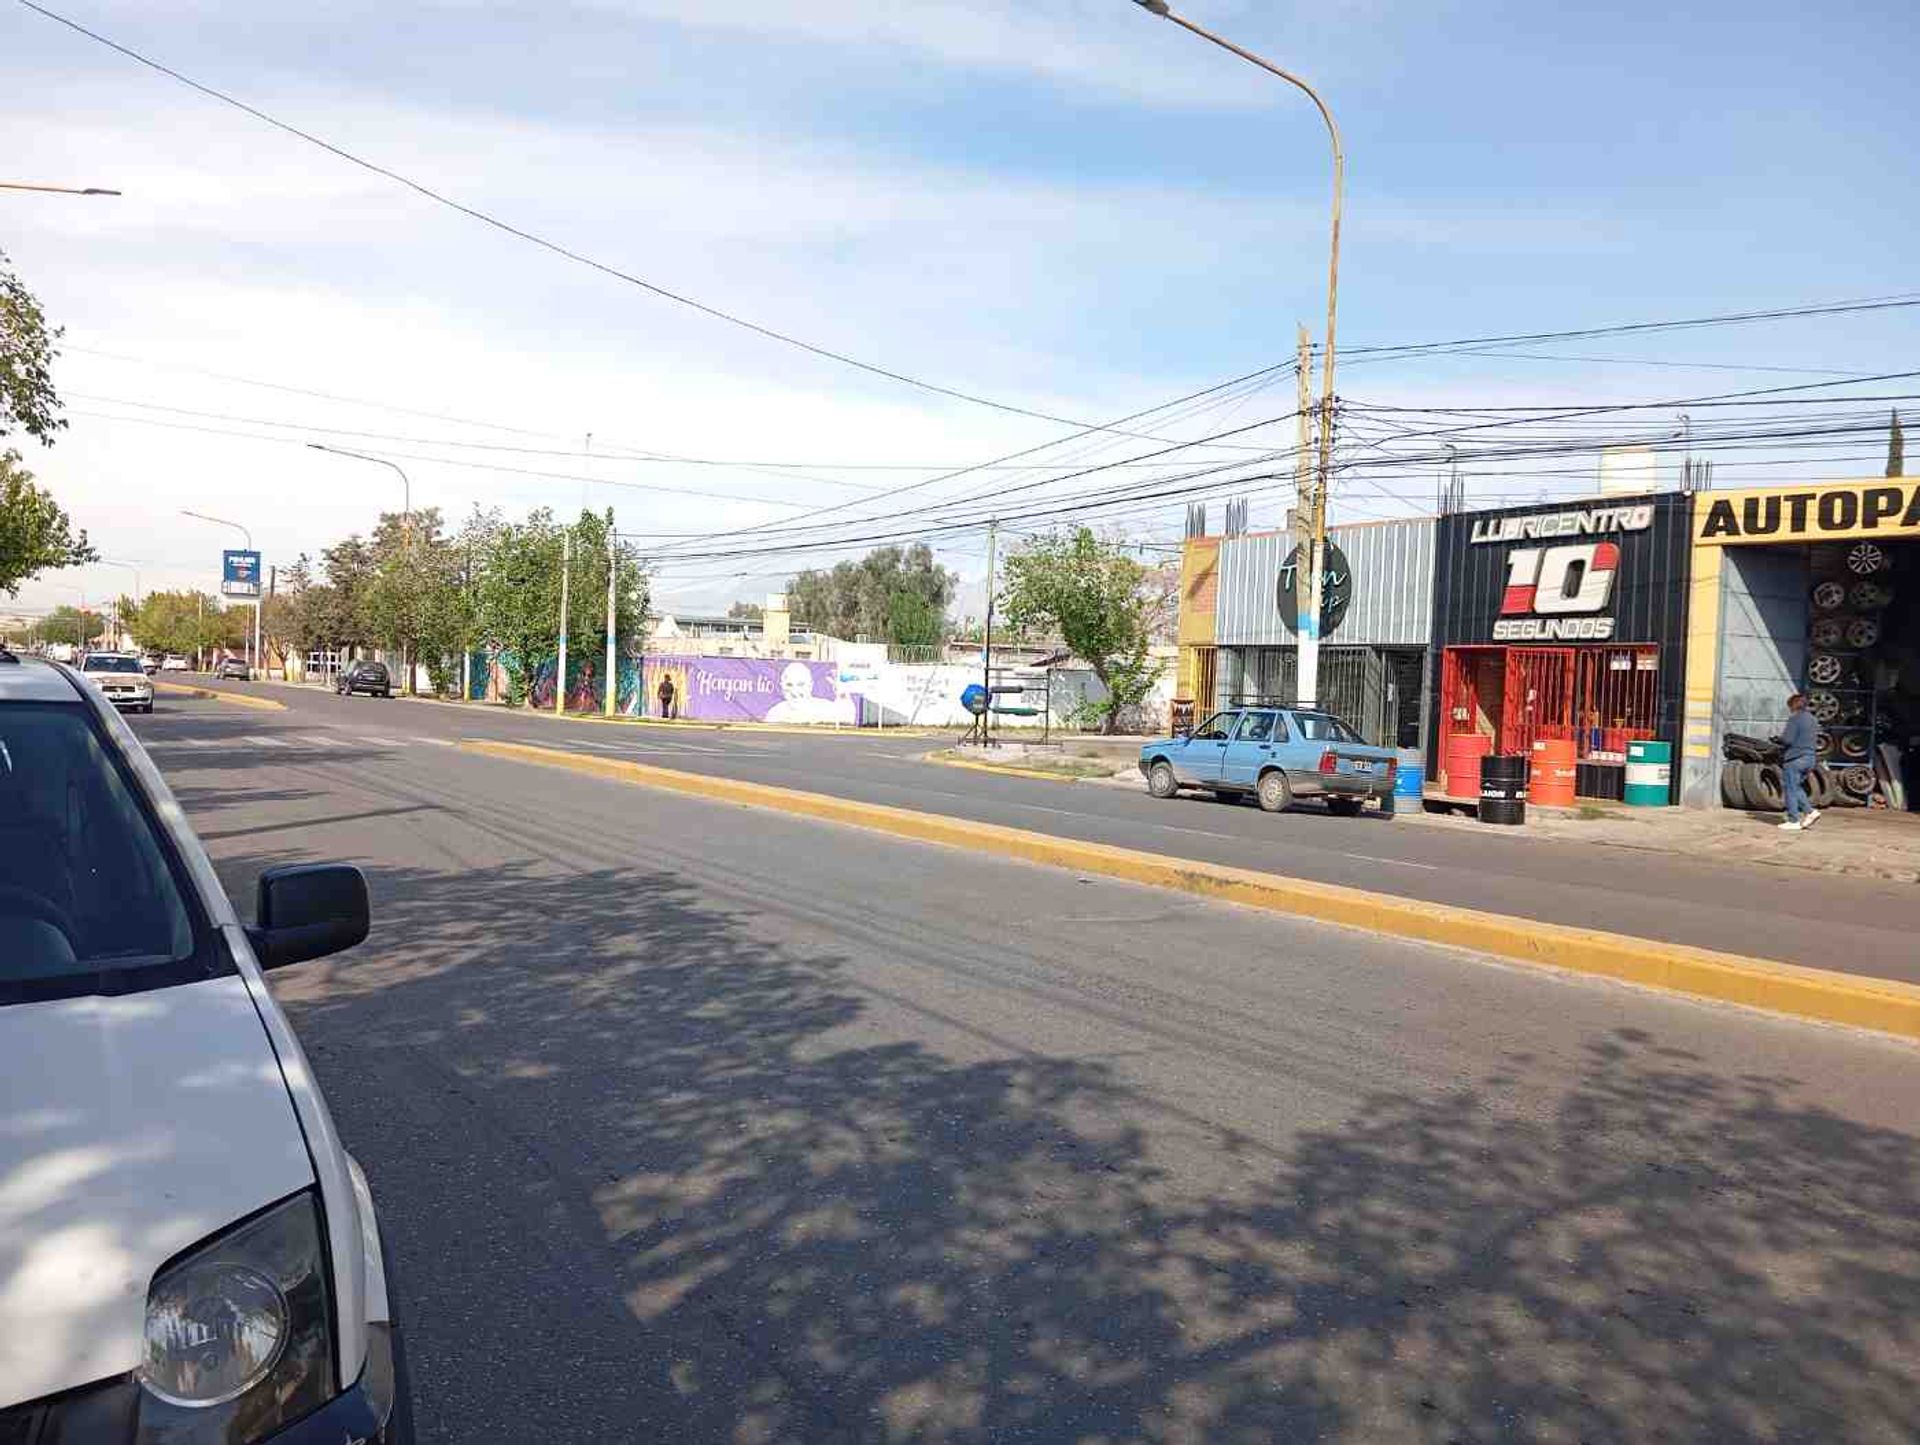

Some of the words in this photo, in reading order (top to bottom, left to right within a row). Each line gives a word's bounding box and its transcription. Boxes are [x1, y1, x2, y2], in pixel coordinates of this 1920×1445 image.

[1470, 504, 1655, 543] LUBRICENTRO
[1501, 542, 1620, 614] 10
[1492, 617, 1615, 640] SEGUNDOS
